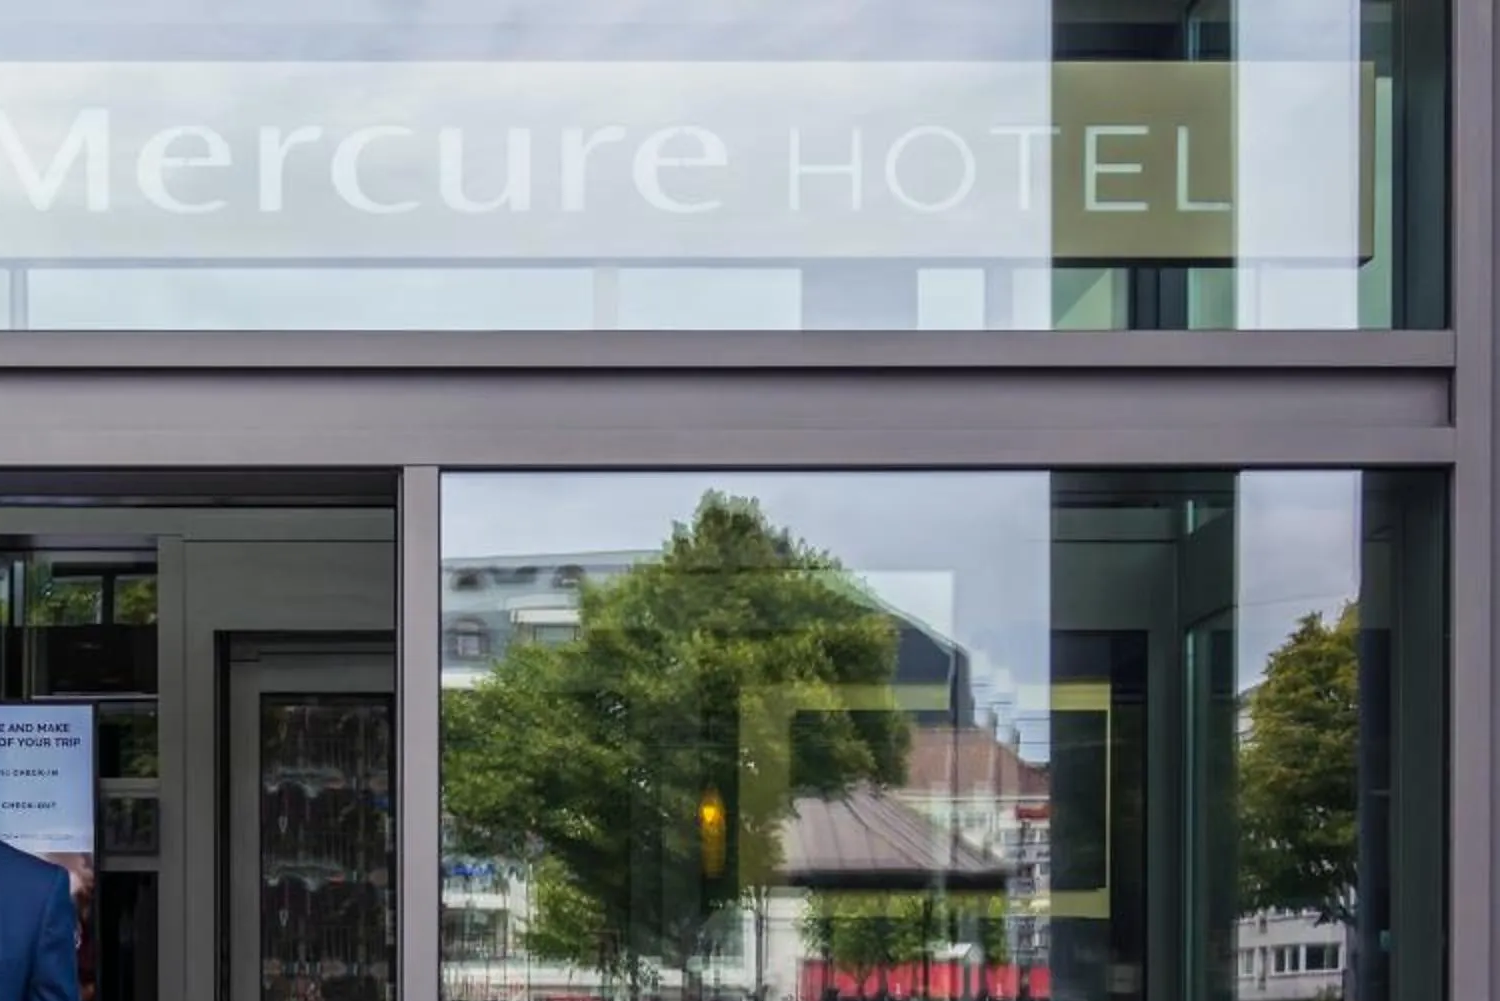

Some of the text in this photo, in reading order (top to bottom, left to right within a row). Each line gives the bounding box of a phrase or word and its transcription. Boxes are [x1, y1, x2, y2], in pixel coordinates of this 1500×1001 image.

[789, 125, 1233, 211] HOTEL
[7, 723, 34, 733] AND
[37, 723, 71, 733] MAKE
[16, 738, 51, 747] YOUR
[55, 738, 81, 747] TRIP
